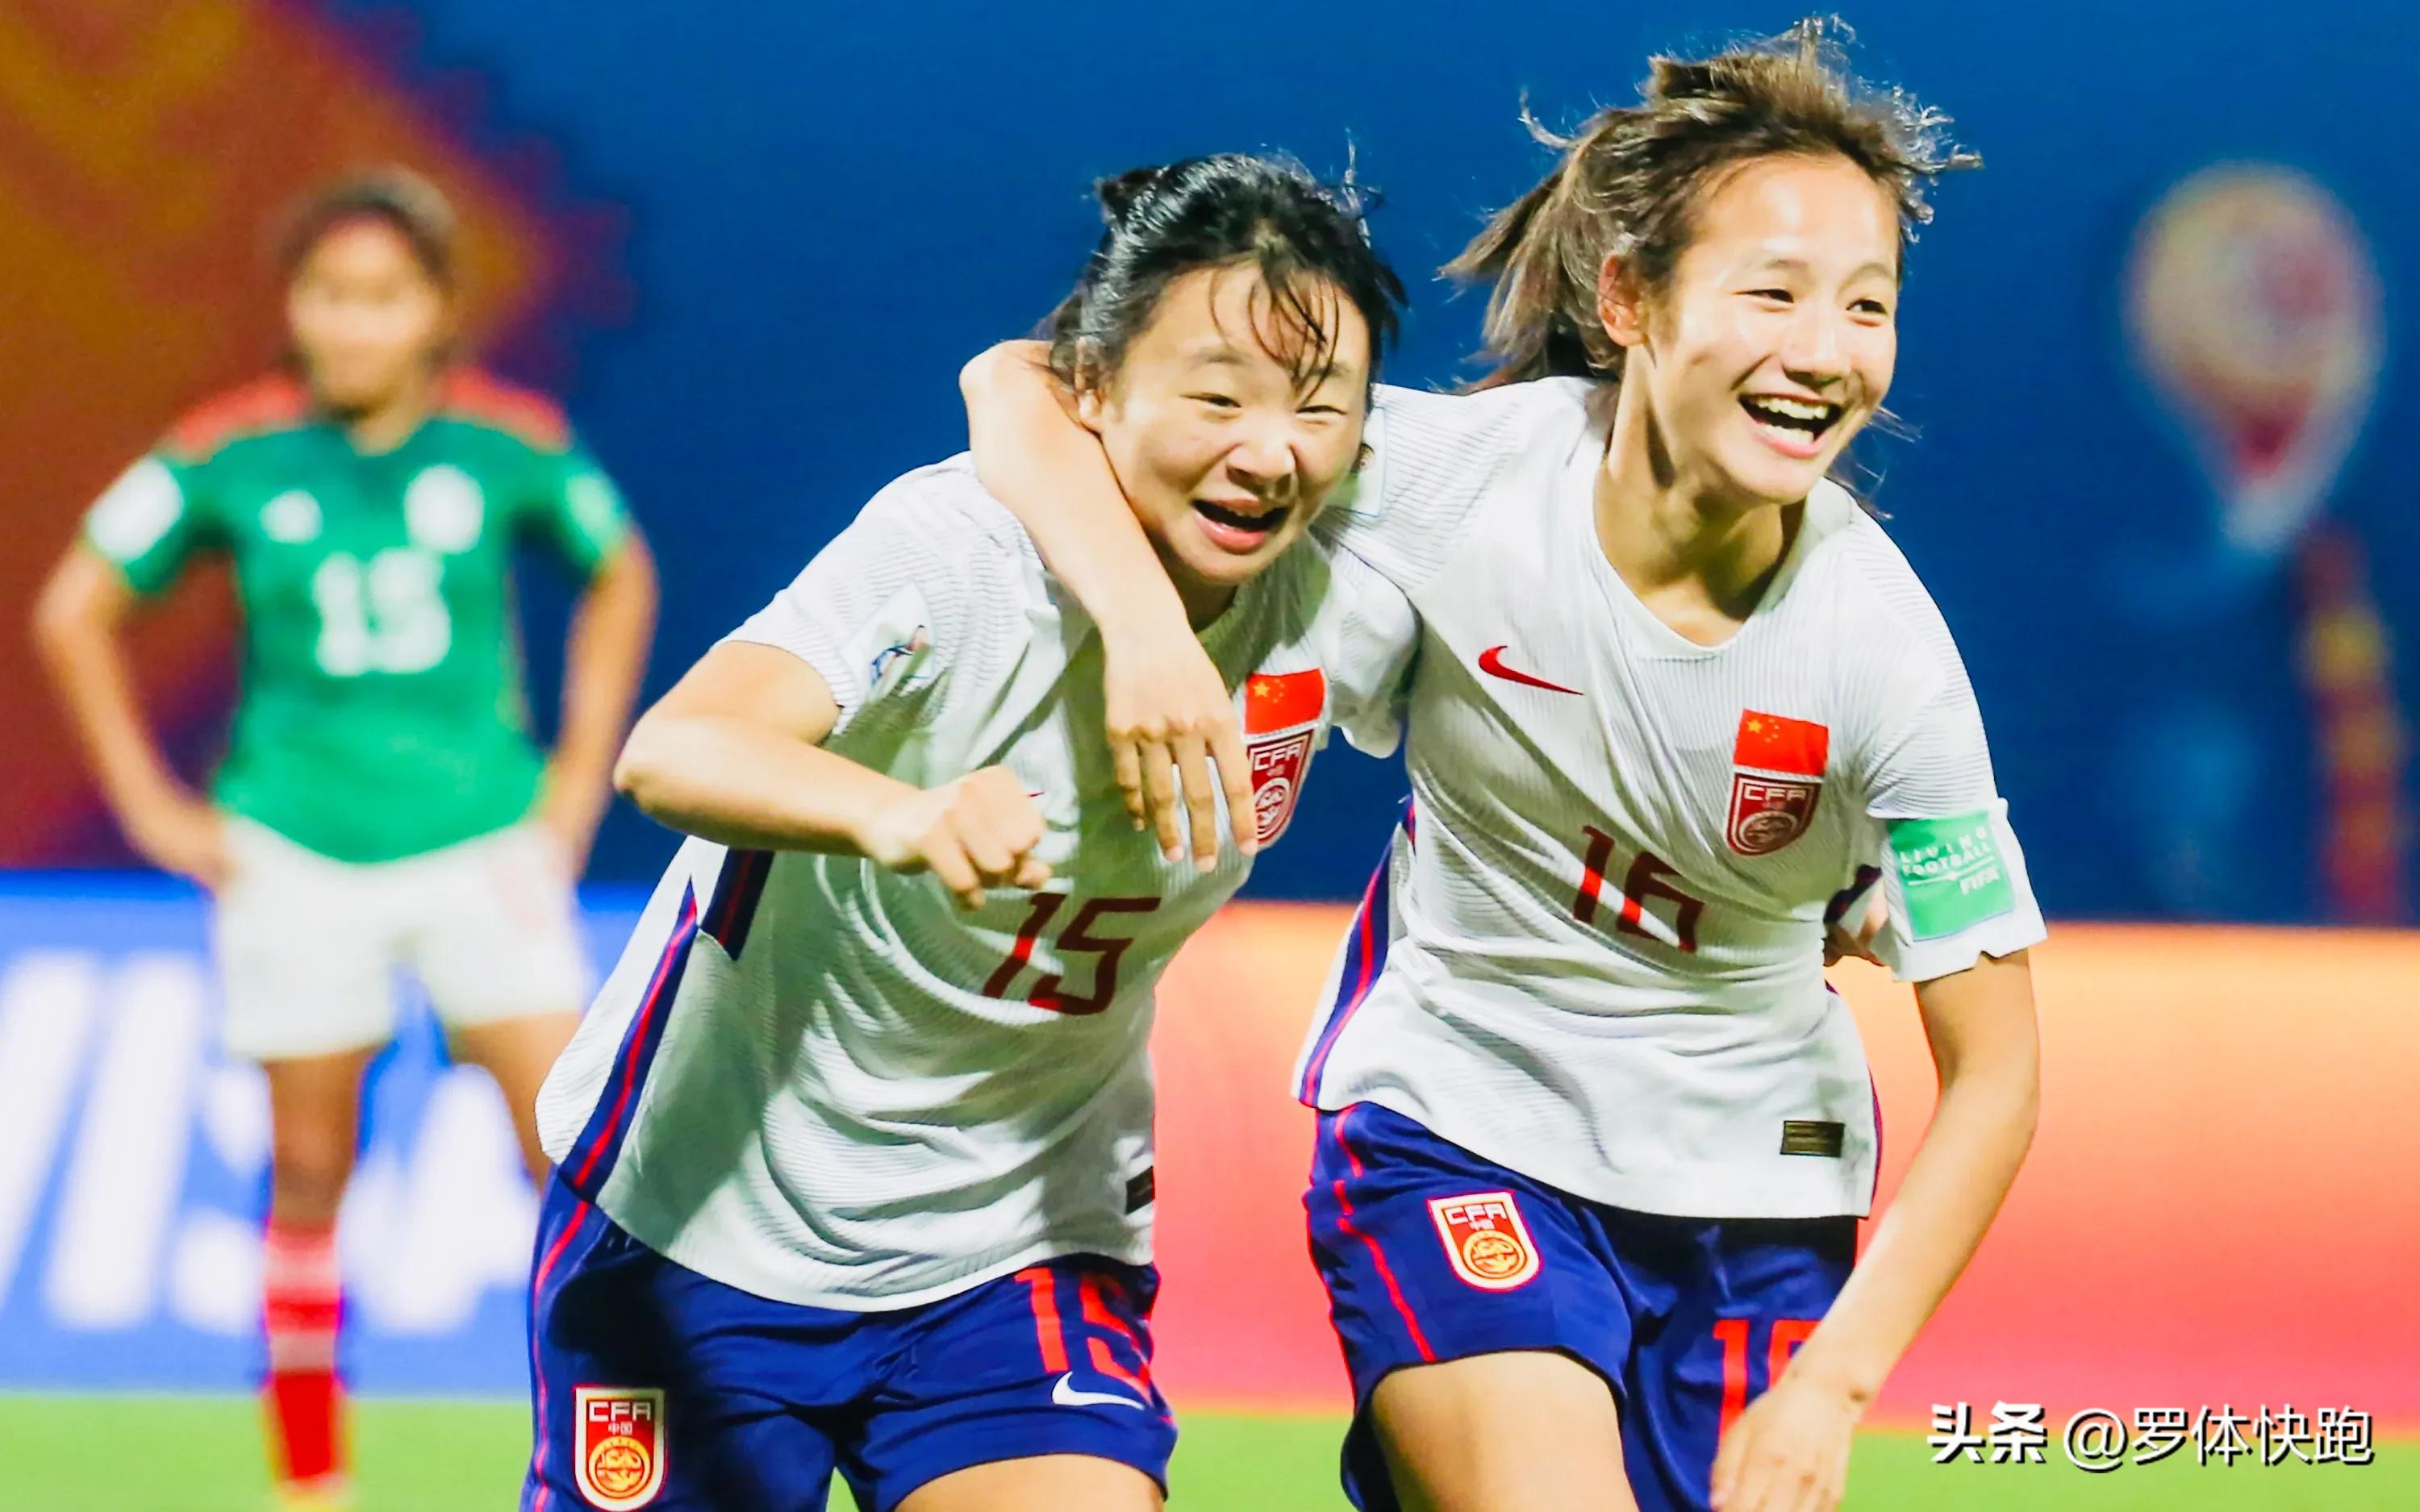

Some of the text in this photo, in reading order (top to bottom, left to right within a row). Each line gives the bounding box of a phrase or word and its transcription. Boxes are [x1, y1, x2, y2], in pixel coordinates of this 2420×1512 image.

[1743, 785, 1807, 802] CFA
[1901, 841, 1991, 877] FOOTBALL
[1572, 825, 1705, 953] 16
[1959, 864, 2001, 895] FIFA
[983, 892, 1161, 1016] 15
[1444, 1202, 1508, 1225] CFA
[1014, 1267, 1154, 1407] 15
[589, 1401, 651, 1422] CFA
